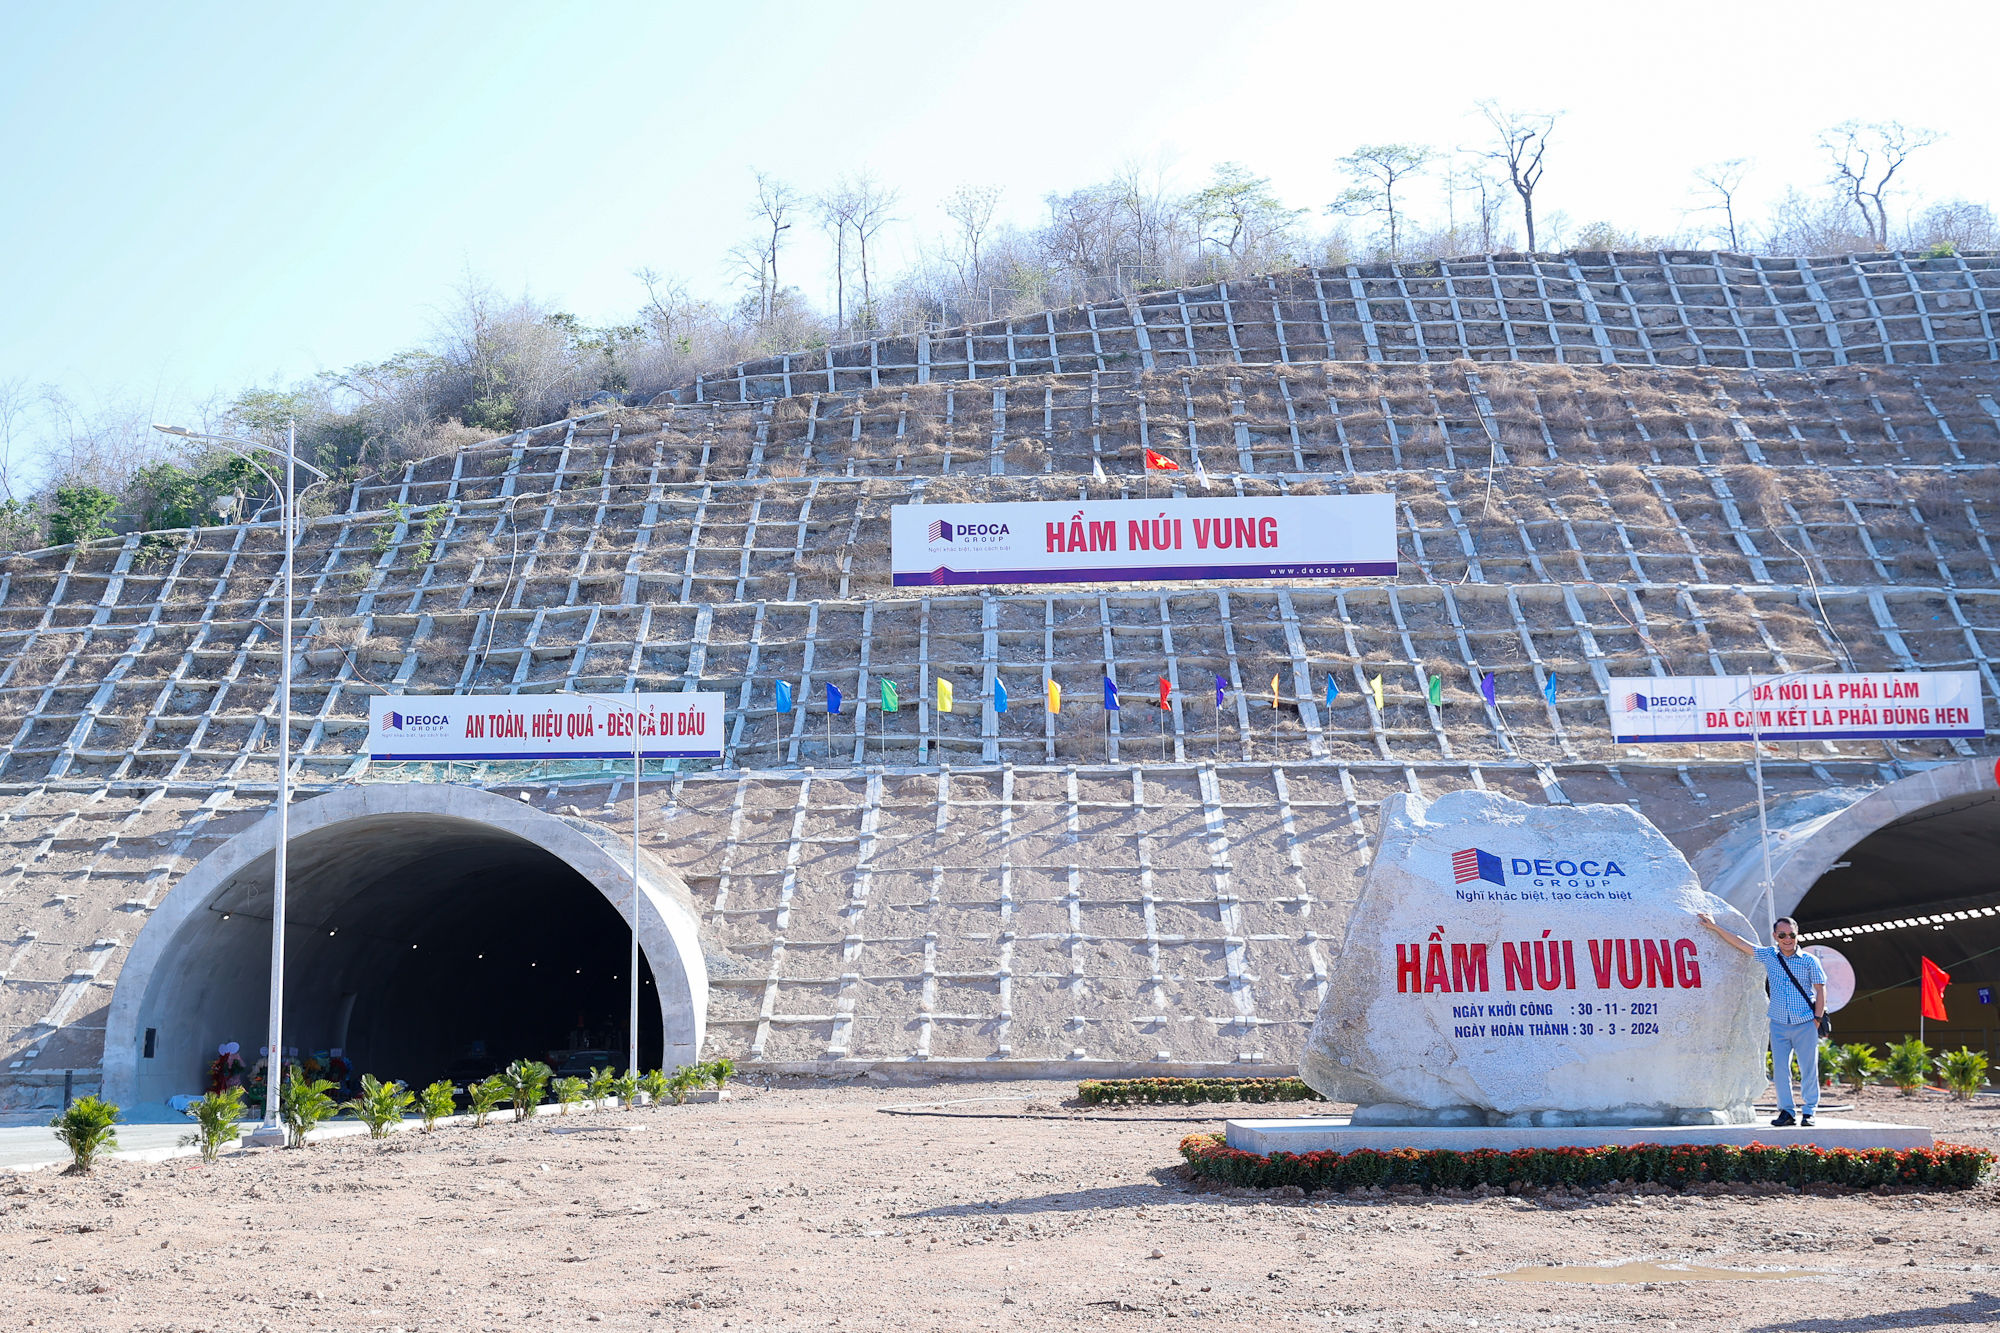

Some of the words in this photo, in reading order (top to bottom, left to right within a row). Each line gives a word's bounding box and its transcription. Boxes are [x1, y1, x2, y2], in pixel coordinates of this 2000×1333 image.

[957, 524, 1010, 535] DEOCA
[1046, 510, 1117, 553] HẦM
[1128, 512, 1182, 550] NÚI
[1192, 516, 1278, 549] VUNG
[1269, 567, 1355, 575] www.deoca.vn
[1779, 680, 1808, 701] NÓI
[1813, 680, 1834, 700] LÀ
[1838, 677, 1878, 700] PHẢI
[1883, 679, 1920, 699] LÀM
[1650, 696, 1696, 706] DEOCA
[406, 715, 449, 725] DEOCA
[465, 714, 484, 738] AN
[489, 708, 527, 741] TOÀN,
[532, 708, 563, 743] HIỆU
[567, 705, 594, 740] QUẢ
[607, 707, 634, 737] ĐÈO
[638, 704, 656, 737] CẢ
[660, 712, 673, 736] ĐI
[677, 703, 705, 736] ĐẦU
[1706, 708, 1729, 728] ĐÃ
[1777, 704, 1807, 726] KẾT
[1812, 706, 1834, 726] LÀ
[1838, 703, 1878, 725] PHẢI
[1882, 705, 1930, 725] ĐÚNG
[1935, 707, 1970, 728] HẸN
[1511, 858, 1626, 877] DEOCA
[1533, 879, 1611, 888] GROUP
[1456, 889, 1485, 902] Nghĩ
[1488, 890, 1518, 901] khác
[1521, 890, 1549, 902] biệt,
[1551, 892, 1573, 902] tạo
[1575, 890, 1606, 900] cách
[1609, 891, 1633, 902] biệt
[1396, 925, 1490, 993] HẦM
[1502, 929, 1576, 991] NÚI
[1587, 938, 1702, 990] VUNG
[1453, 1002, 1484, 1018] NGÀY
[1488, 1001, 1516, 1017] KHỞI
[1520, 1001, 1553, 1016] CÔNG
[1578, 1003, 1593, 1015] 30
[1605, 1003, 1618, 1015] 11
[1630, 1003, 1658, 1015] 2021
[1454, 1022, 1486, 1038] NGÀY
[1490, 1022, 1524, 1037] HOÀN
[1529, 1021, 1569, 1036] THÀNH
[1579, 1023, 1594, 1035] 30
[1608, 1023, 1616, 1035] 3
[1631, 1023, 1660, 1035] 2024
